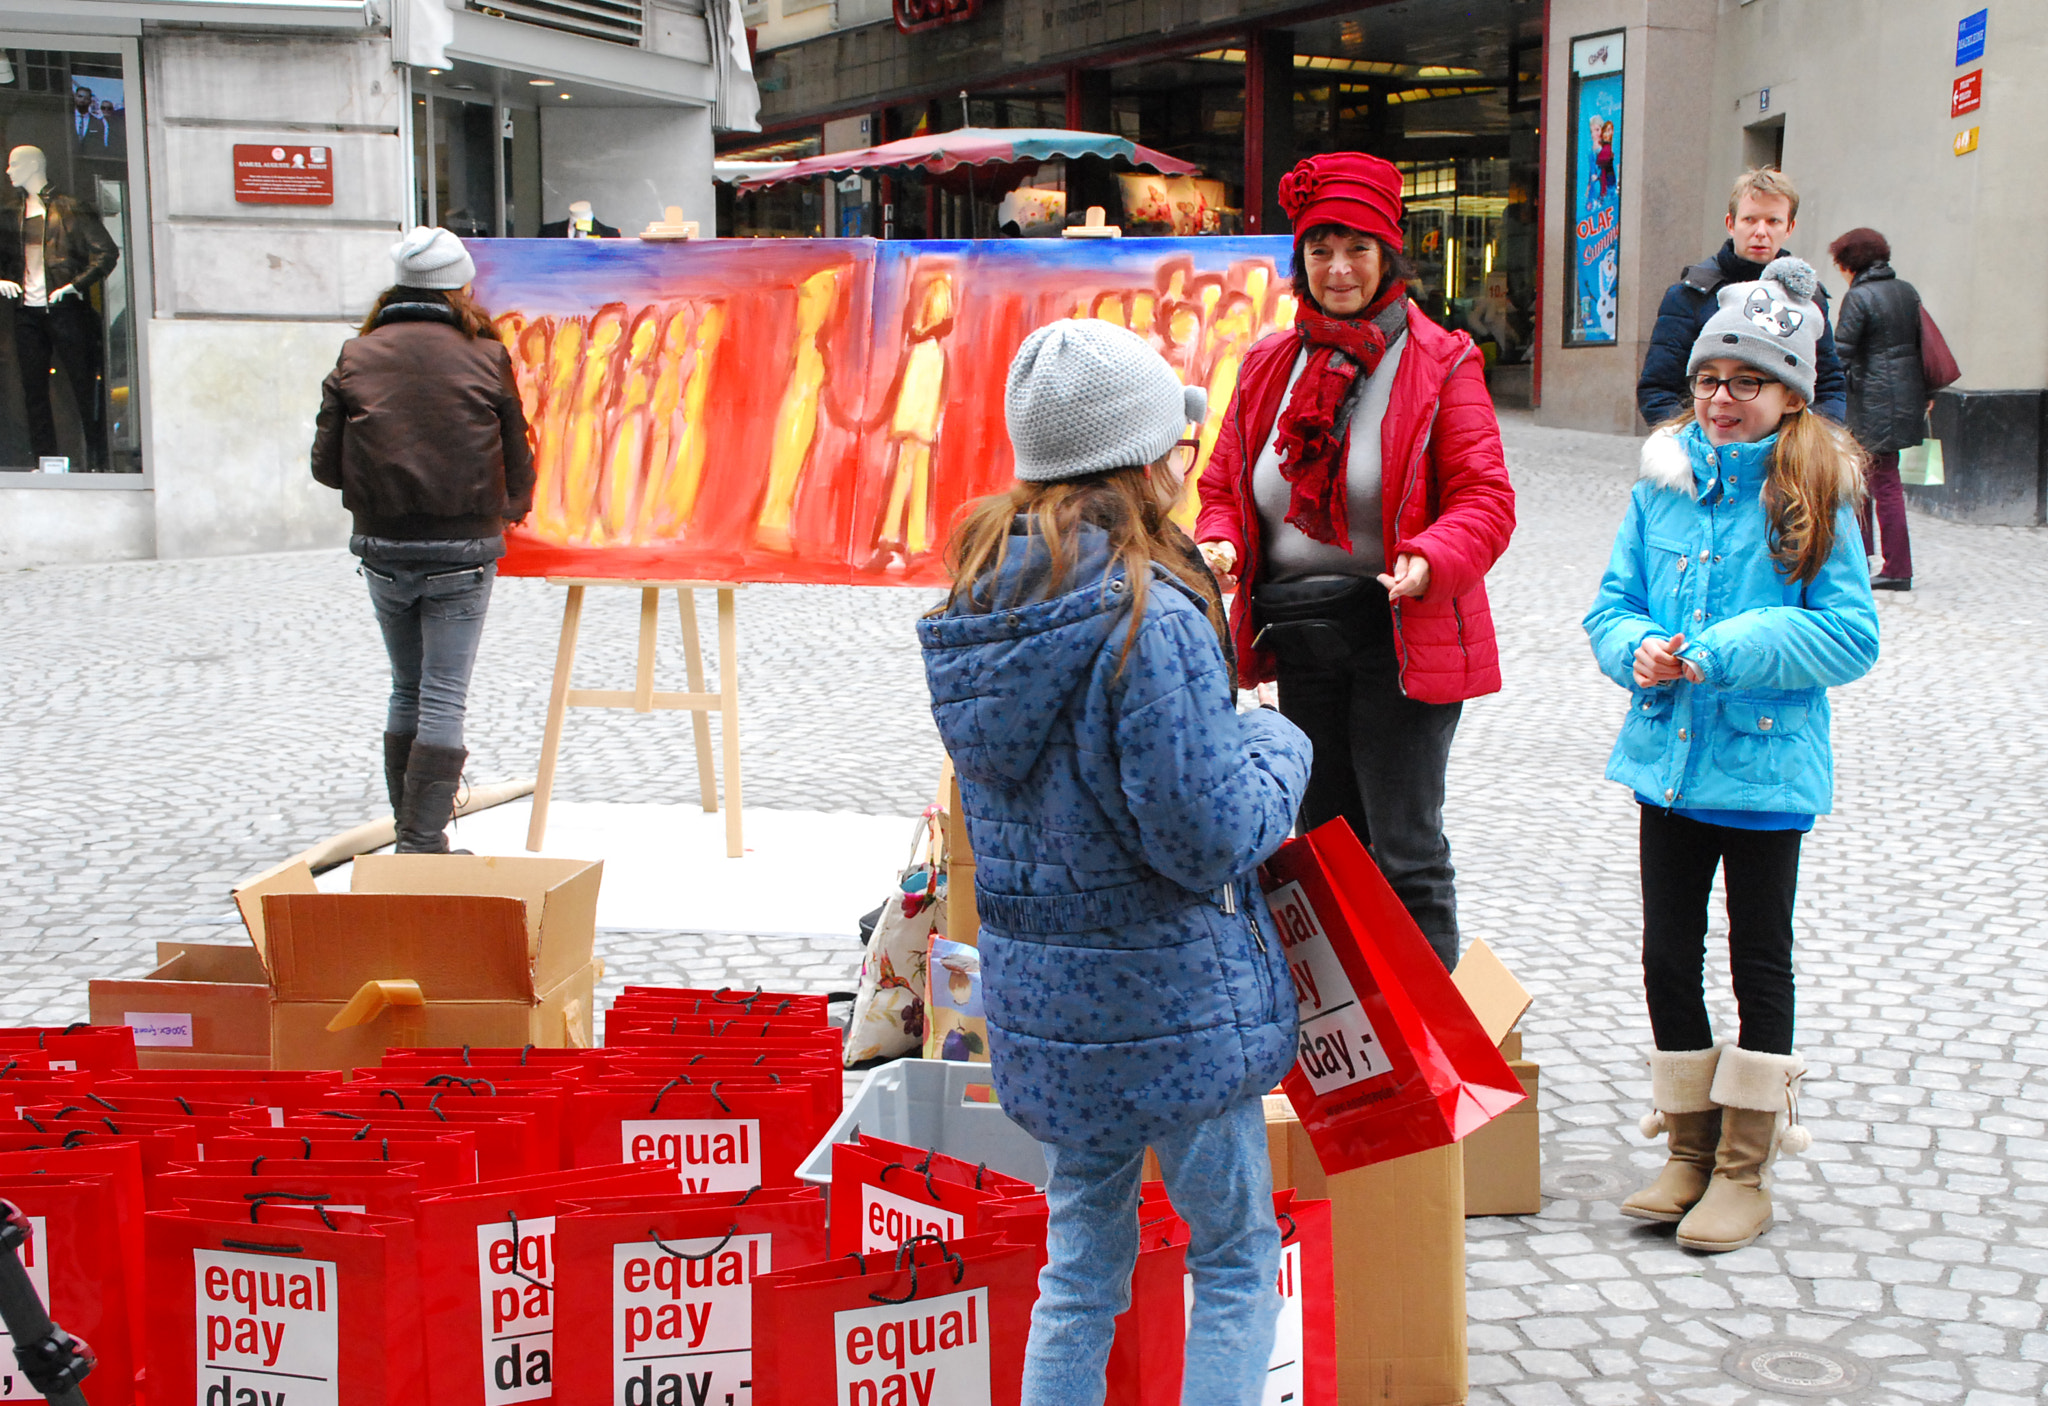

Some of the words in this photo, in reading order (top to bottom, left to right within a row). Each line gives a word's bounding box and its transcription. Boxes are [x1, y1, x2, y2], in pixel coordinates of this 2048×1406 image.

[1577, 206, 1614, 239] OLAF
[631, 1124, 749, 1174] equal
[204, 1265, 326, 1315] equal
[623, 1240, 758, 1300] equal
[206, 1314, 285, 1367] pay
[624, 1301, 712, 1353] pay
[846, 1295, 978, 1370] equal
[848, 1367, 936, 1406] pay
